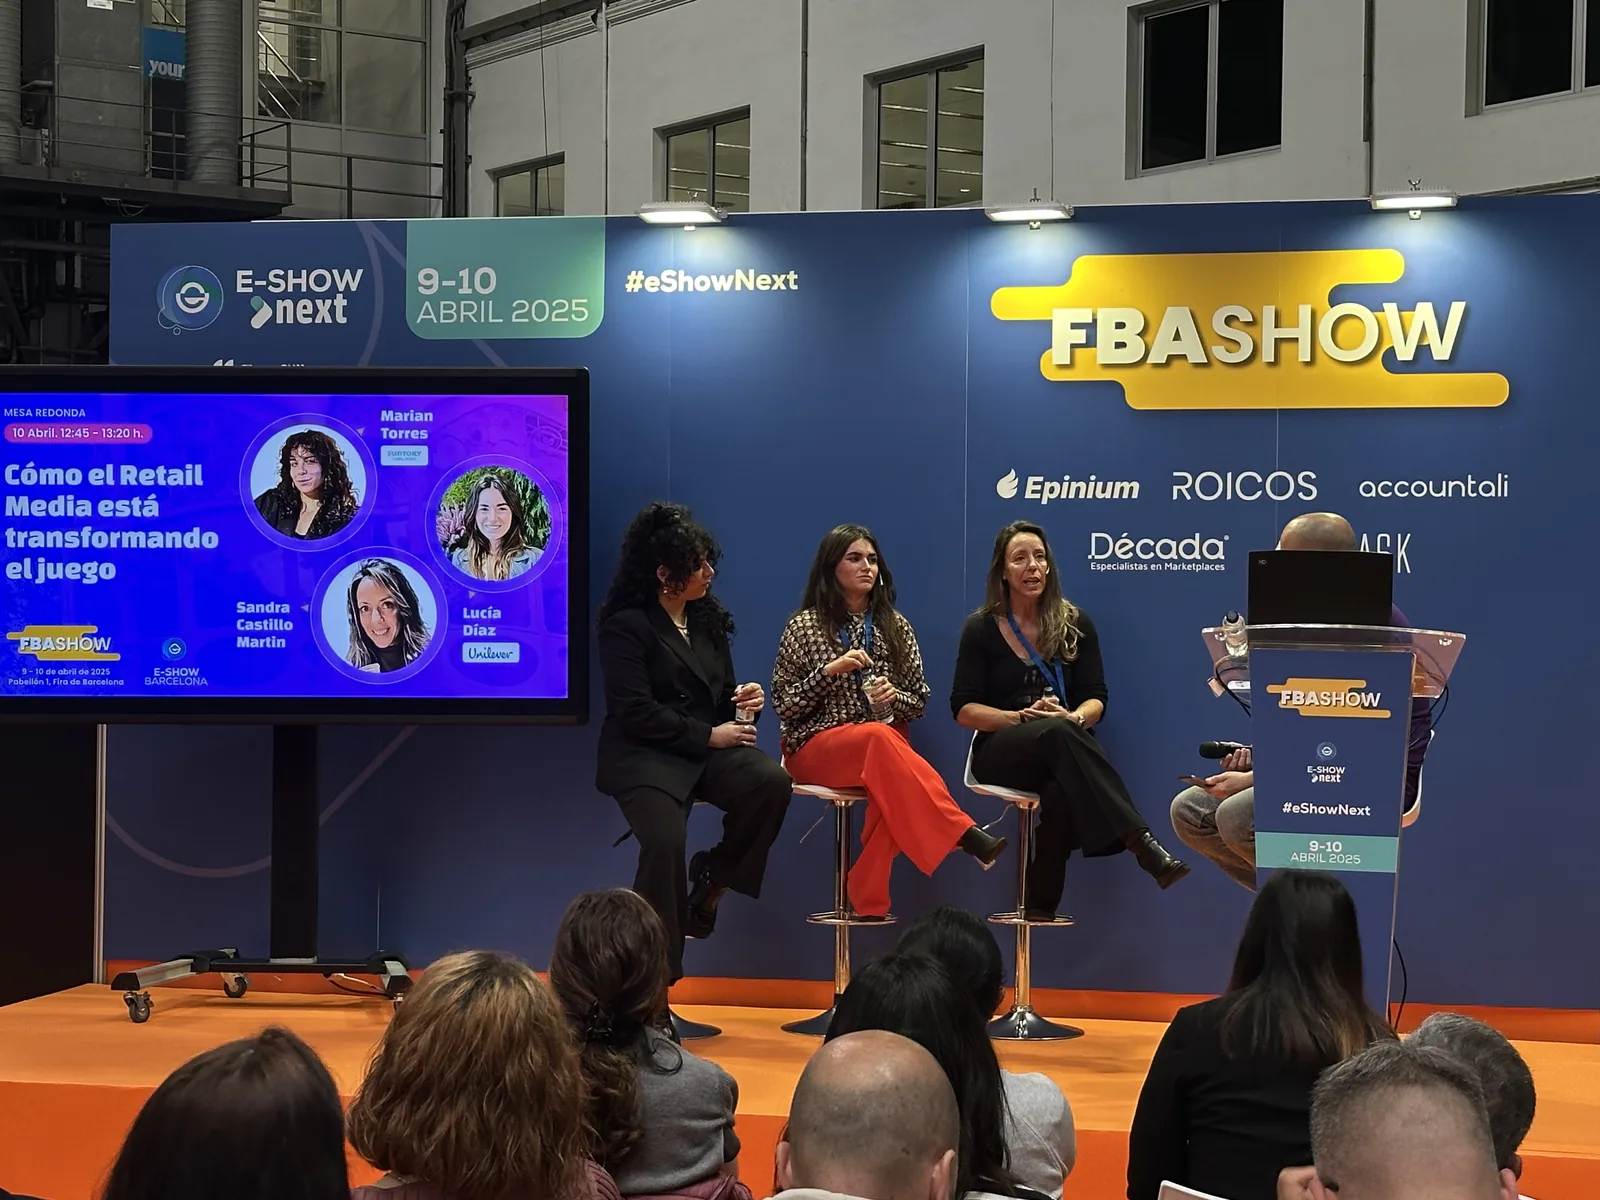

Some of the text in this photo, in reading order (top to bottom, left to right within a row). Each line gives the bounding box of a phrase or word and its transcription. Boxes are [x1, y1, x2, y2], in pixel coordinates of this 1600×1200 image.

[236, 268, 364, 293] E-SHOW
[416, 266, 497, 295] 9-10
[625, 268, 799, 294] #eShowNext
[275, 293, 348, 324] next
[416, 298, 589, 323] ABRIL 2025
[1051, 301, 1467, 365] FBASHOW
[4, 408, 86, 417] MESA REDONDA
[381, 409, 434, 422] Marian
[12, 428, 25, 438] 10
[27, 427, 58, 438] Abril.
[60, 428, 90, 438] 12:45
[101, 428, 131, 438] 13:20
[133, 428, 144, 439] h.
[380, 427, 429, 439] Torres
[4, 461, 204, 486] Cómo el Retail
[1024, 474, 1140, 505] Epinium
[1172, 470, 1318, 501] ROICOS
[1359, 472, 1509, 498] accountali
[5, 493, 160, 517] Media está
[5, 526, 219, 549] transformando
[5, 557, 117, 584] el juego
[1090, 562, 1225, 573] Especialistas en Marketplaces
[236, 601, 290, 613] Sandra
[463, 605, 502, 619] Lucía
[236, 618, 294, 631] Castillo
[463, 623, 496, 636] Díaz
[19, 637, 112, 651] FBASHOW
[236, 636, 286, 648] Martin
[468, 646, 514, 660] Unilever
[21, 668, 28, 676] 9
[35, 668, 44, 676] 10
[45, 668, 56, 676] de
[58, 667, 77, 676] abril
[78, 668, 89, 676] de
[91, 668, 111, 676] 2025
[153, 668, 200, 677] E-SHOW
[8, 677, 124, 687] Pabellón 1, Fira de Barcelona
[144, 677, 208, 686] BARCELONA
[1281, 690, 1381, 707] FBASHOW
[1307, 766, 1346, 774] E-SHOW
[1319, 773, 1341, 783] next
[1282, 802, 1371, 816] #eShowNext
[1308, 841, 1342, 852] 9-10
[1290, 853, 1361, 864] ABRIL 2025
